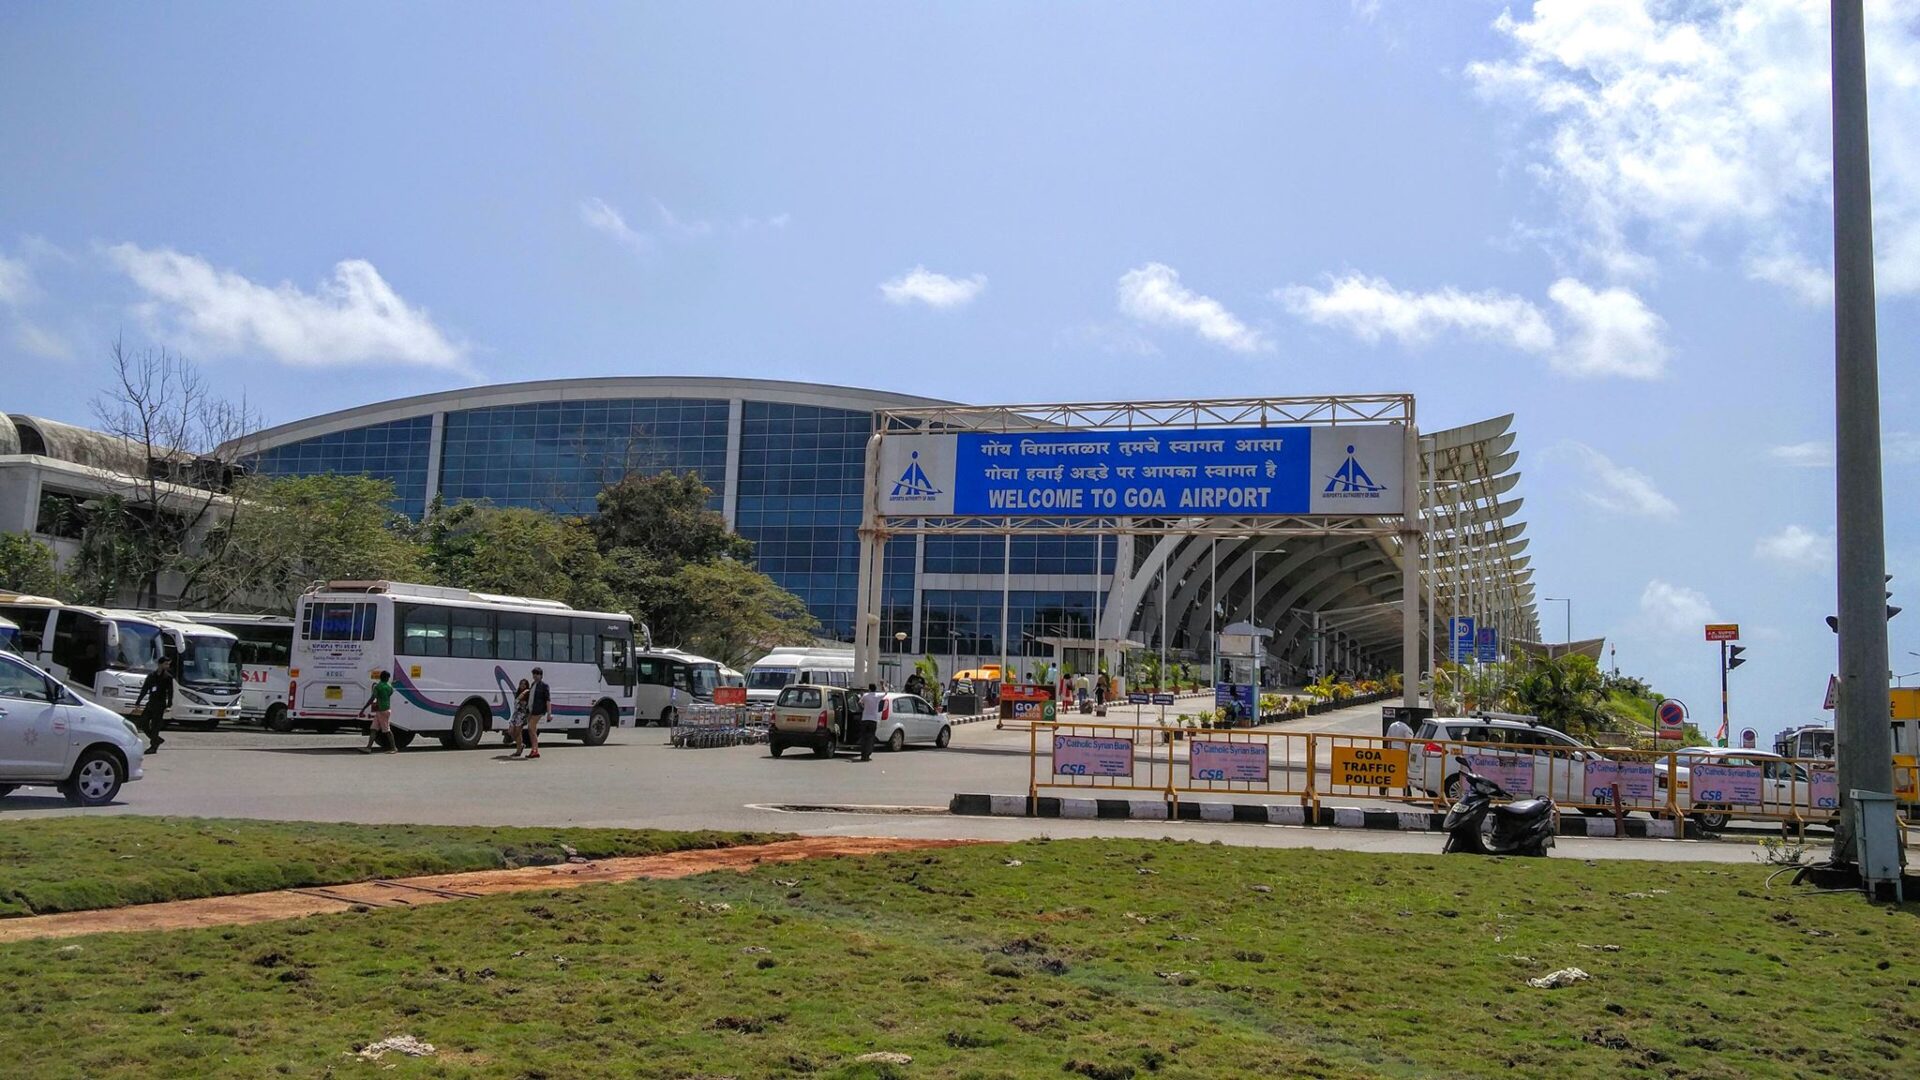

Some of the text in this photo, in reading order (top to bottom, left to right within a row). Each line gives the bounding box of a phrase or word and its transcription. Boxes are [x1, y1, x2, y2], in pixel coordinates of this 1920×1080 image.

[981, 437, 1284, 457] गोंय विमानतळार तुमचे स्वागत आसा
[985, 464, 1019, 480] गोवा
[1026, 465, 1065, 482] हवाई
[1116, 467, 1135, 478] पर
[1142, 466, 1197, 478] आपका
[1204, 465, 1258, 478] स्वागत
[1265, 460, 1277, 478] है
[989, 487, 1271, 508] WELCOME TO GOA AIRPORT
[240, 670, 268, 682] SAI
[1015, 703, 1040, 711] GOA
[1066, 739, 1130, 751] Catholic Syrian Bank
[1203, 745, 1265, 756] Catholic Syrian Bank
[1355, 751, 1382, 760] GOA
[1060, 763, 1086, 774] CSB
[1343, 762, 1396, 773] TRAFFIC
[1475, 758, 1498, 767] Catholic
[1519, 760, 1533, 768] Bank
[1198, 768, 1224, 780] CSB
[1619, 766, 1639, 775] yrian
[1639, 766, 1653, 774] Bank
[1705, 768, 1727, 776] Catholic
[1728, 768, 1746, 778] Syrian
[1345, 774, 1392, 785] POLICE
[1700, 790, 1722, 801] CSB
